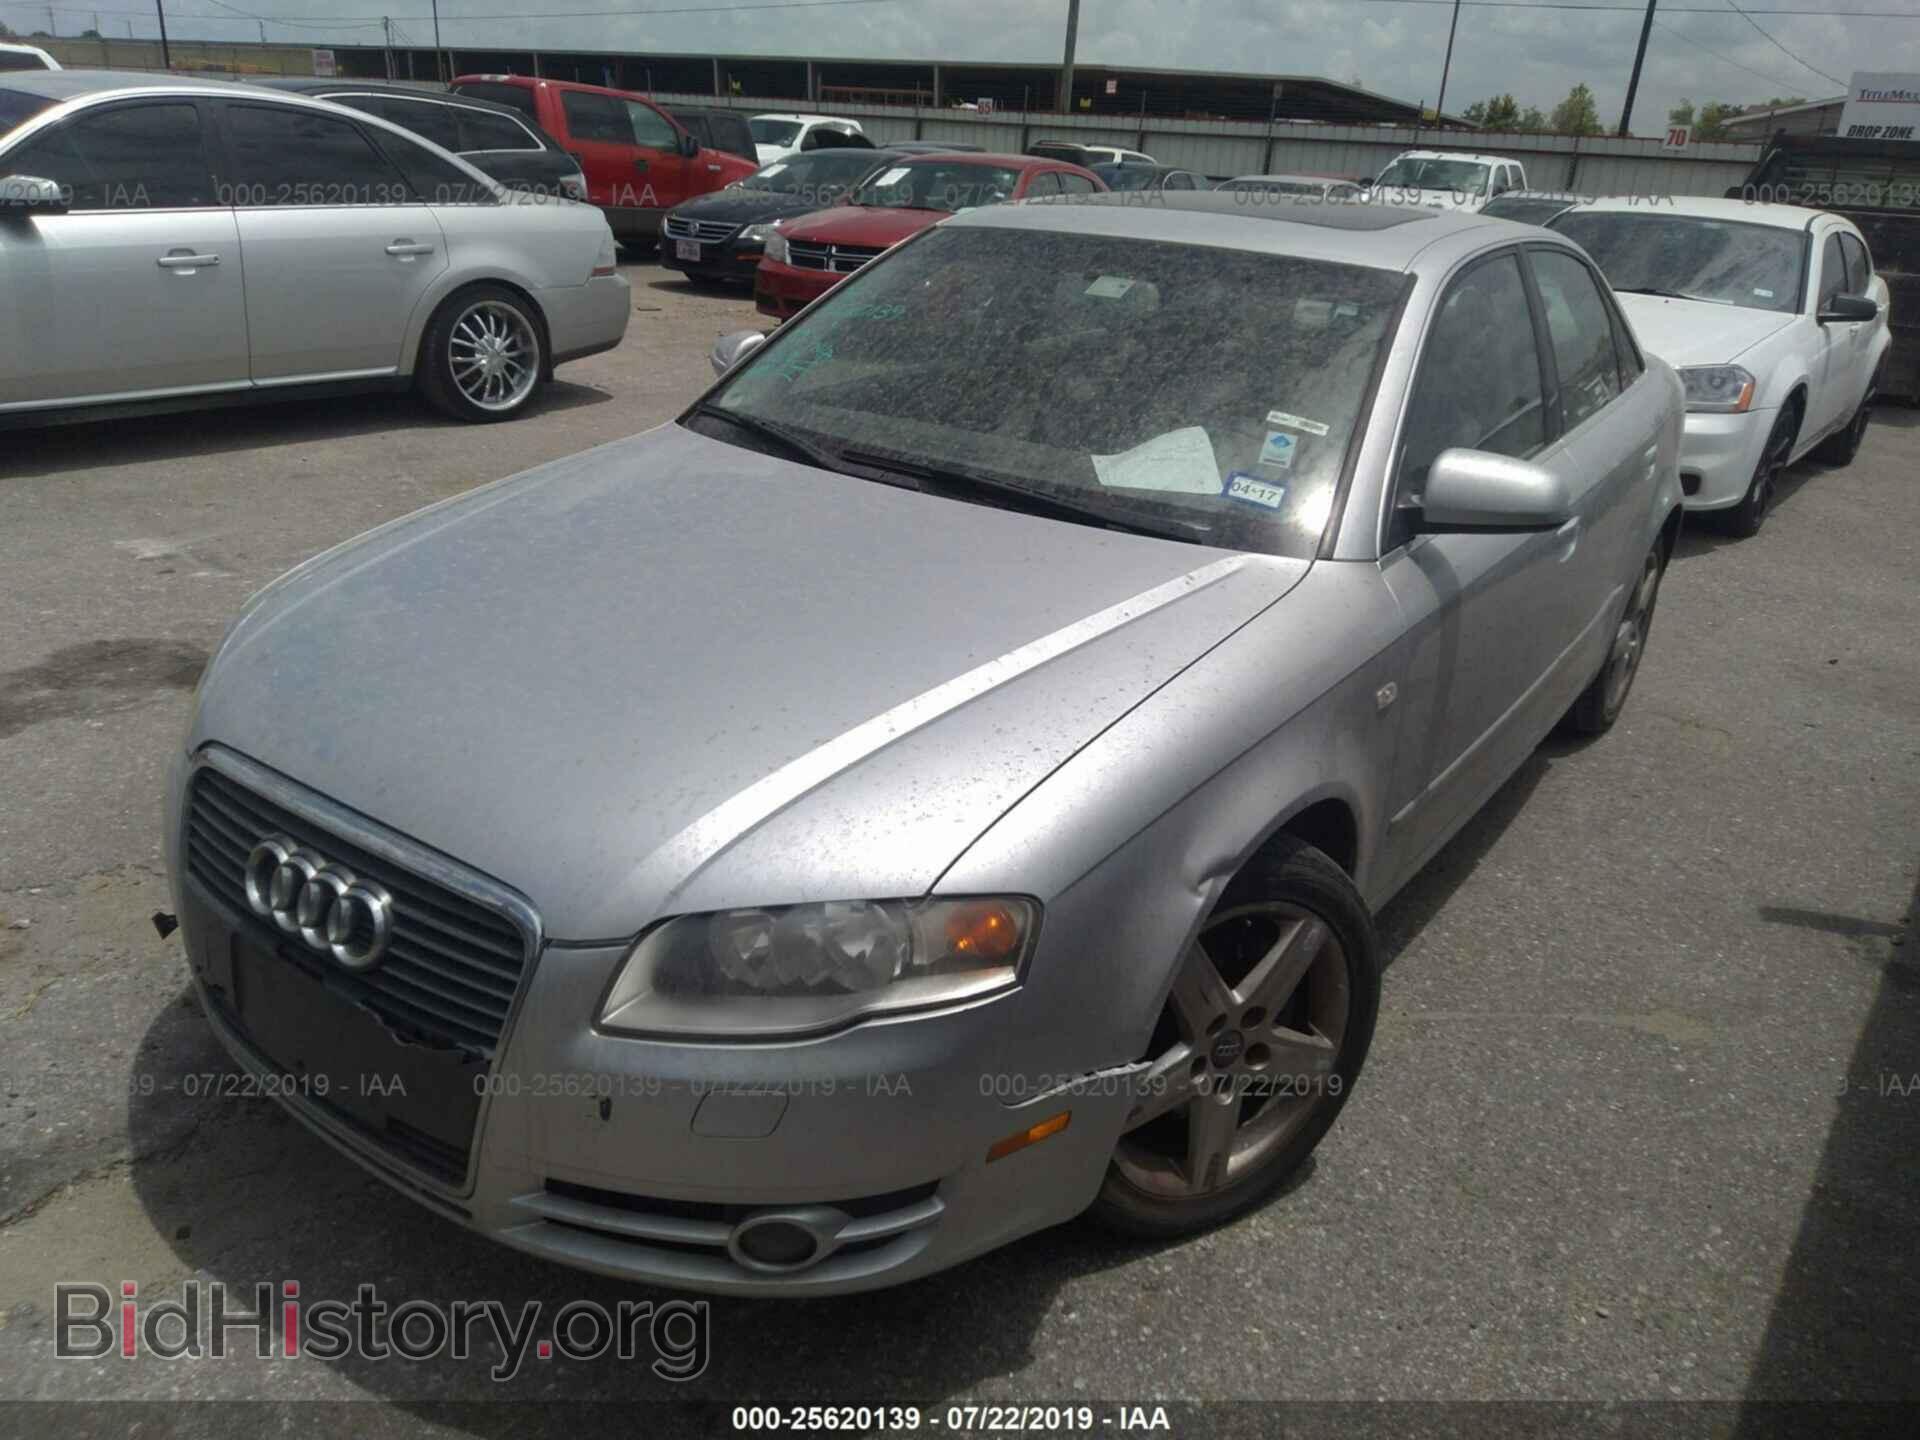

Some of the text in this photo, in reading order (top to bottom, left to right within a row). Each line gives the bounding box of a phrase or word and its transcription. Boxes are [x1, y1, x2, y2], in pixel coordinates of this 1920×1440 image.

[1666, 128, 1687, 145] 70
[1846, 125, 1915, 139] DROP ZONE
